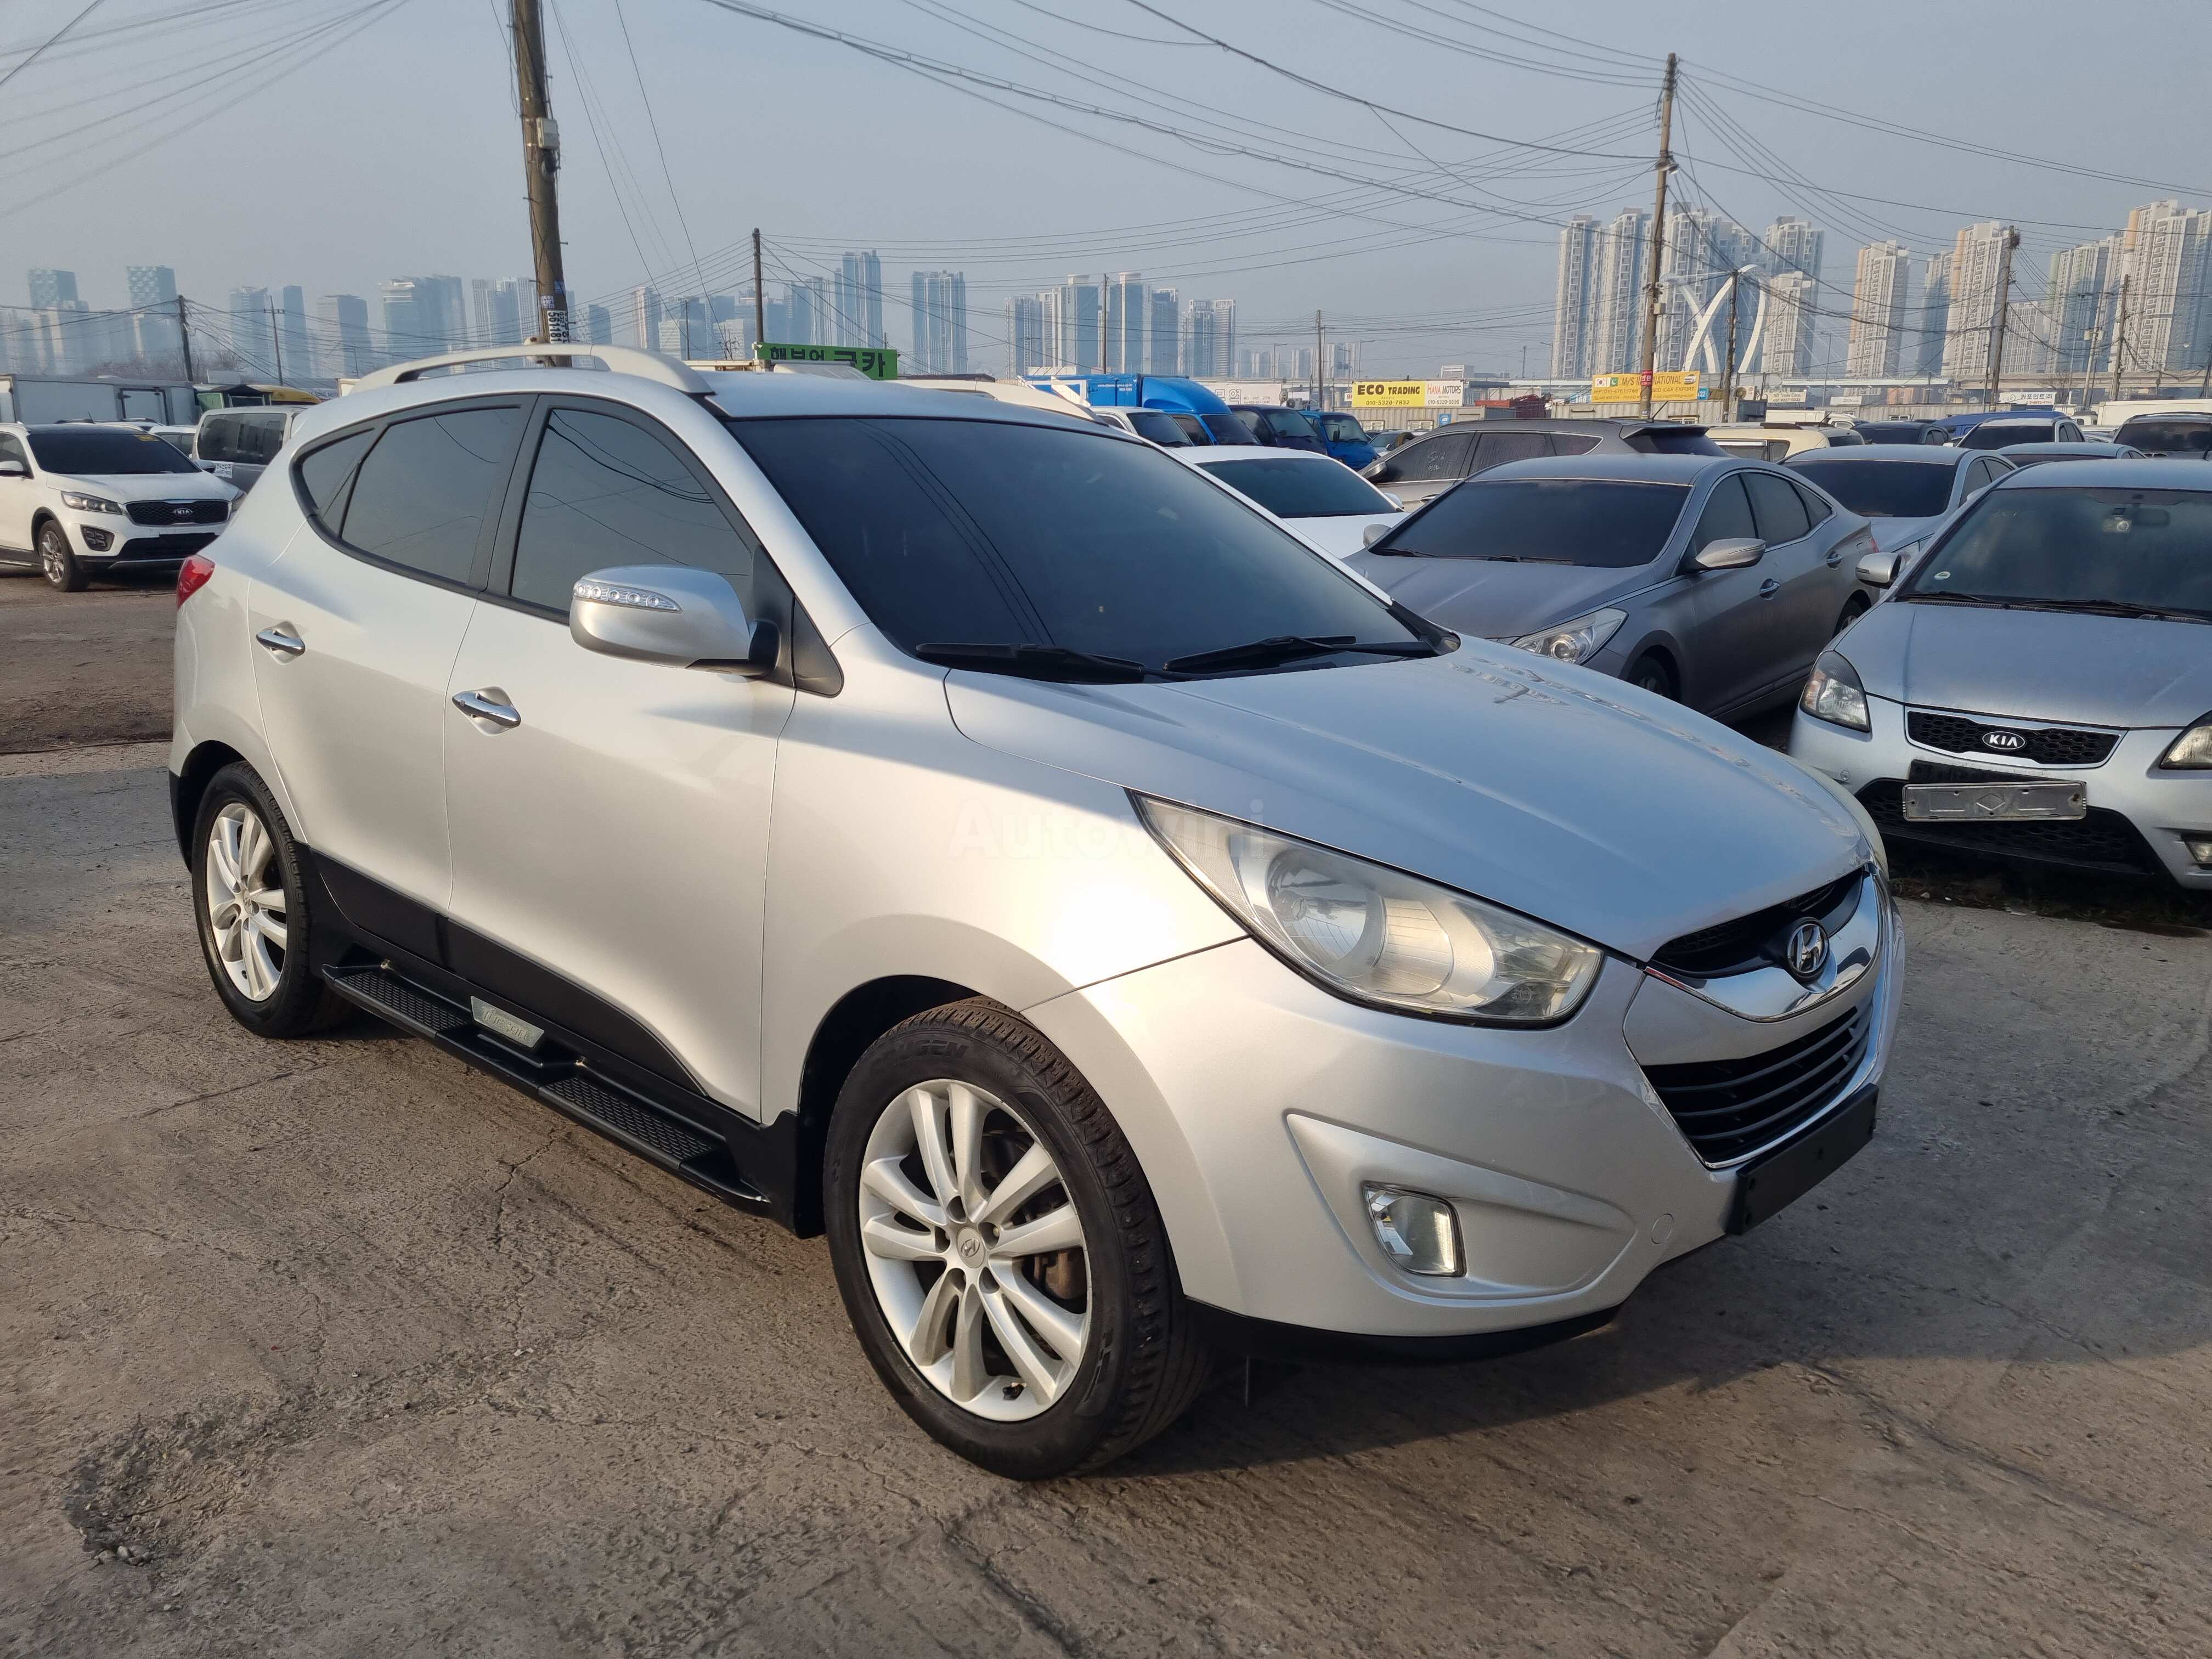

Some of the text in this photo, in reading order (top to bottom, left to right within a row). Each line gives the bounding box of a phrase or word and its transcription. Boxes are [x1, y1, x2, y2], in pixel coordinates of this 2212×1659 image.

[1622, 377, 1634, 386] M/S
[1357, 385, 1420, 395] ECO TRADING
[1427, 383, 1461, 394] HANA MOTORS
[1989, 734, 2018, 747] KIA
